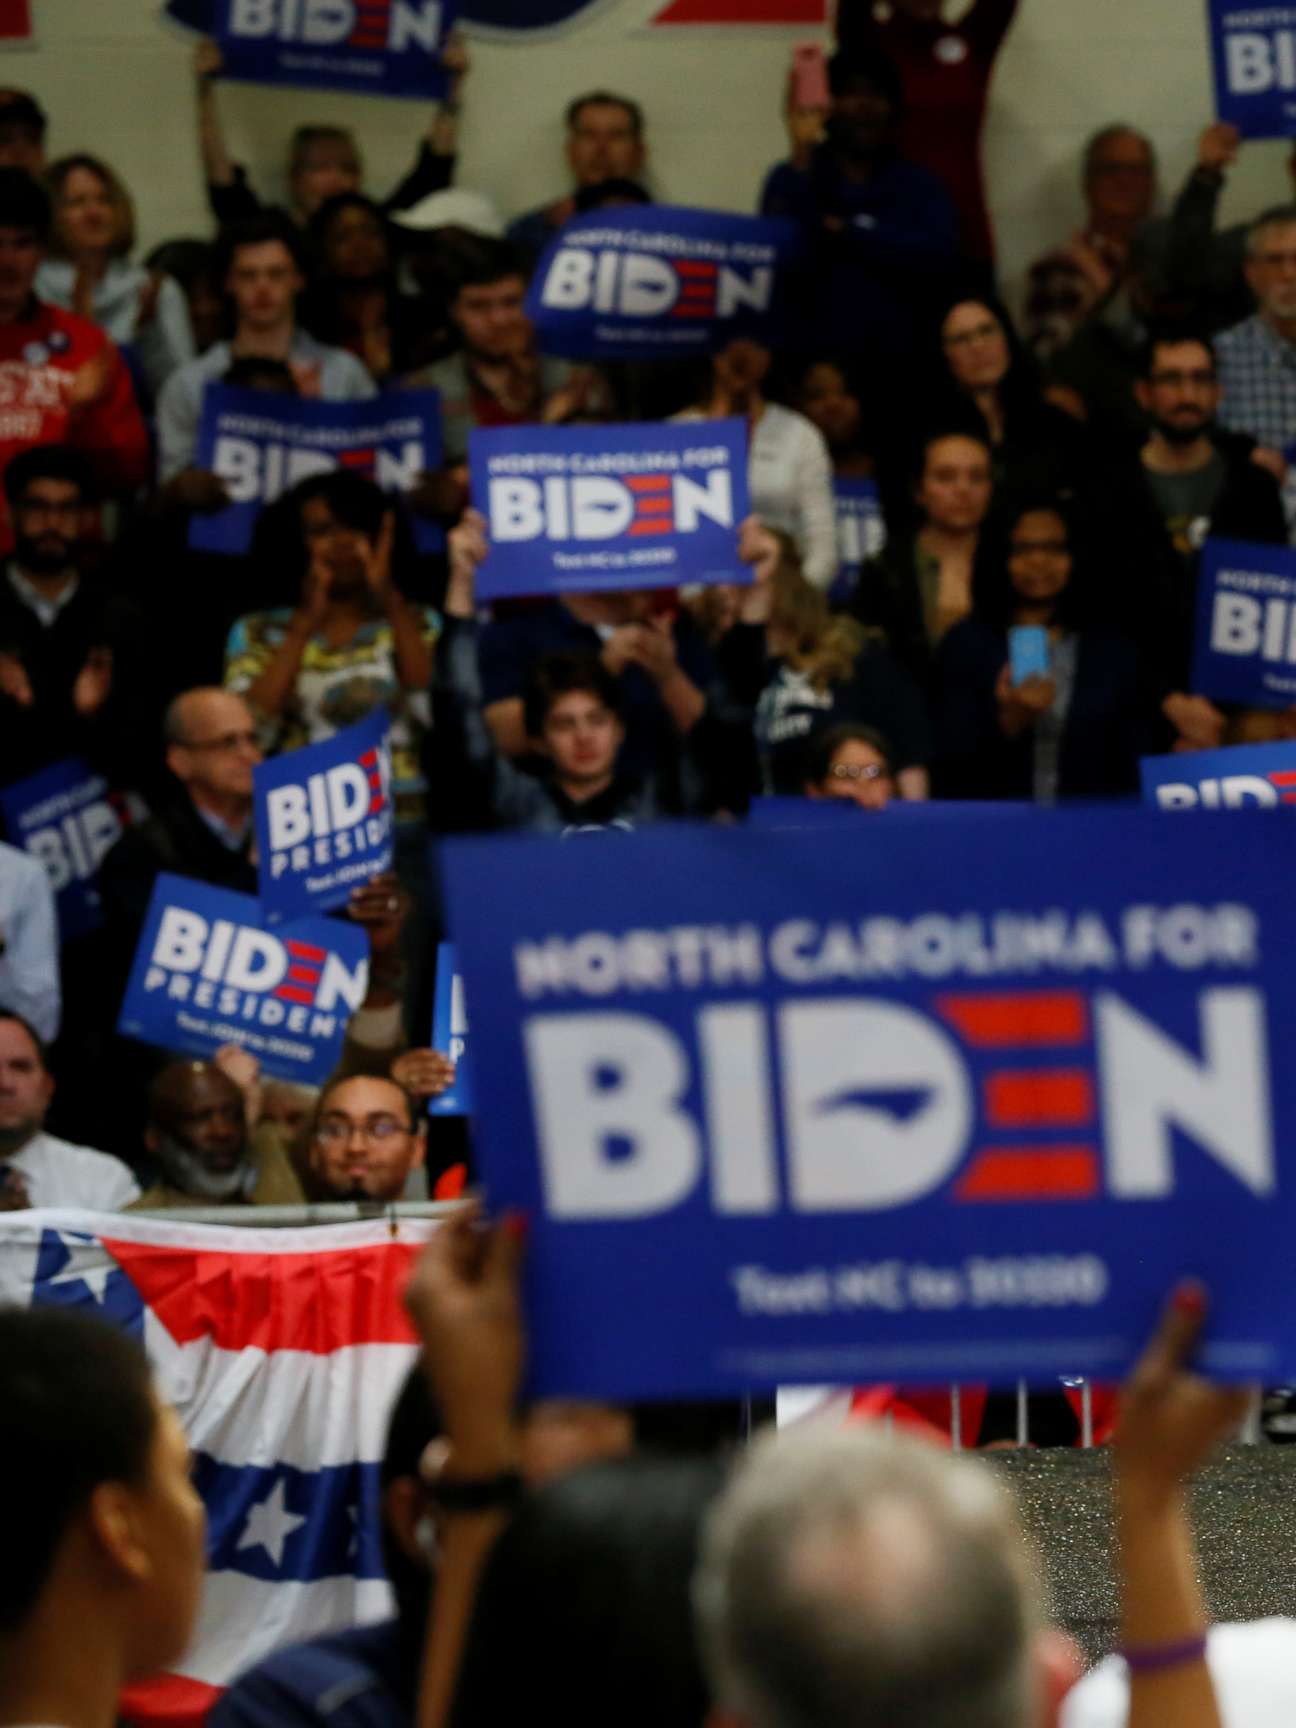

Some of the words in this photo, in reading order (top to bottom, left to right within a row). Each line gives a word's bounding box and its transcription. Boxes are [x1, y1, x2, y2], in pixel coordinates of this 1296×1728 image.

[227, 0, 444, 52] BIDEN
[541, 246, 774, 318] BIDEN
[488, 467, 734, 543] BIDEN
[266, 743, 391, 852] BIDE
[270, 812, 390, 880] PRESID
[152, 904, 370, 1013] BIDEN
[515, 924, 764, 999] NORTH
[769, 908, 1118, 986] CAROLINA
[1121, 901, 1260, 971] FOR
[143, 966, 349, 1039] PRESIDEN
[523, 985, 1276, 1219] BIDEN
[733, 1260, 830, 1317] Text
